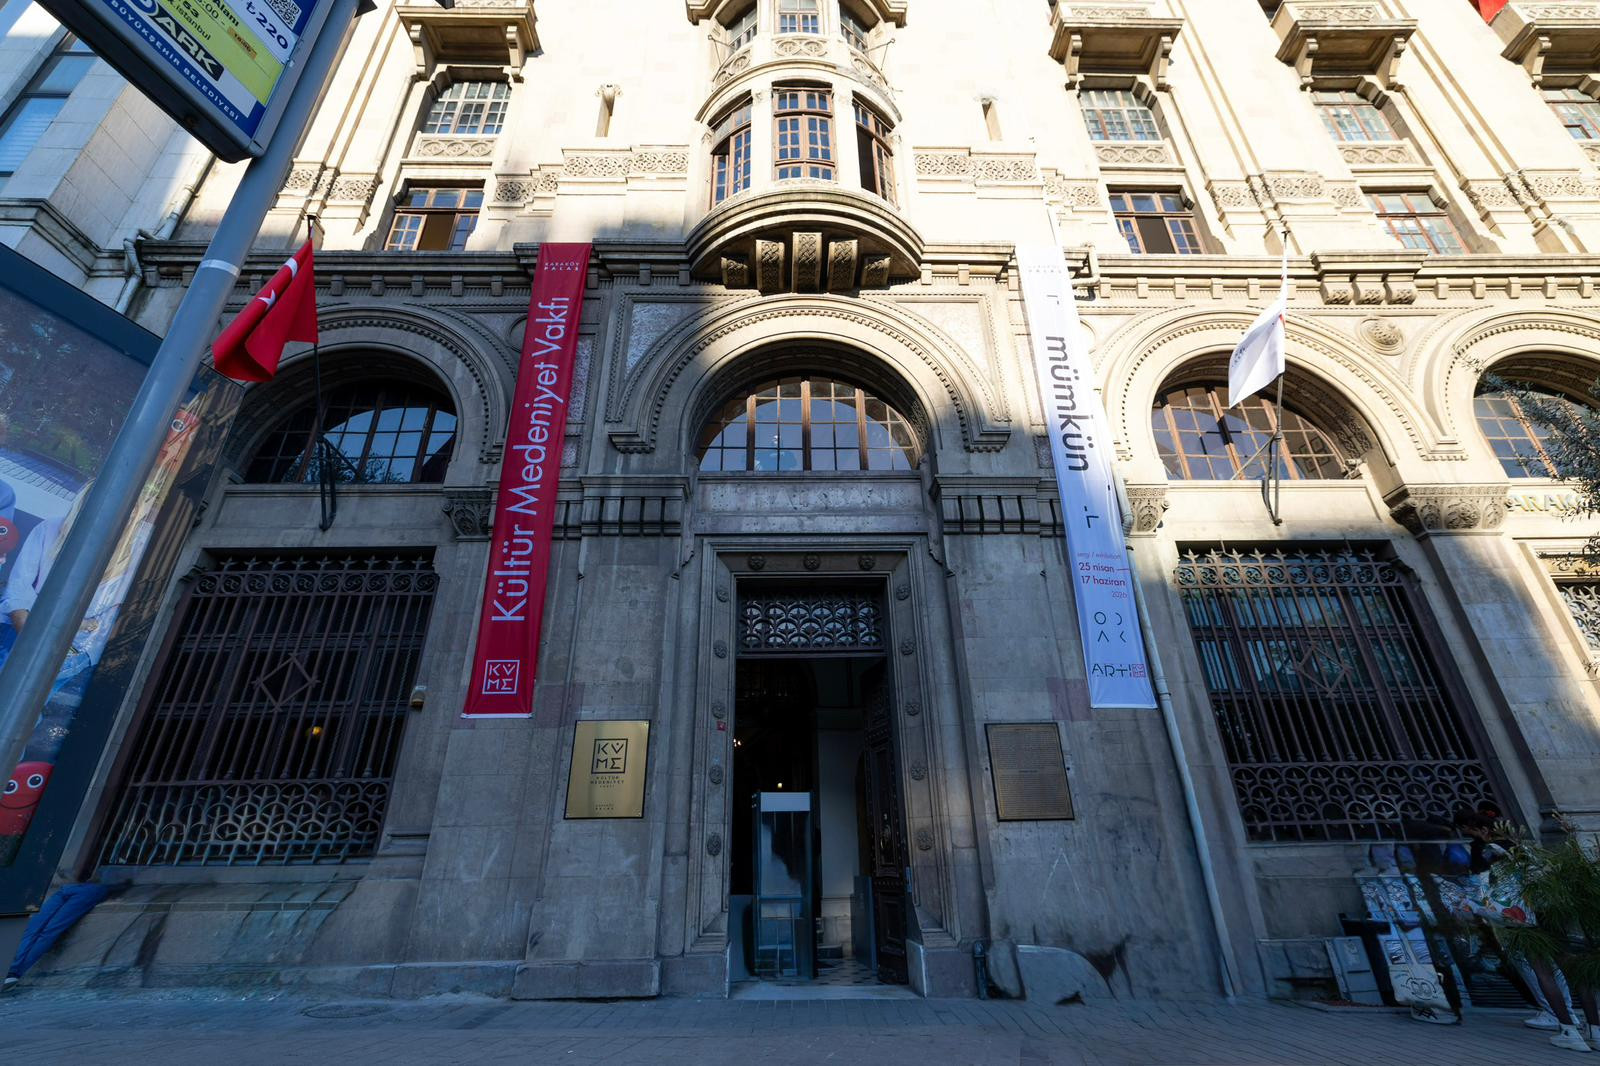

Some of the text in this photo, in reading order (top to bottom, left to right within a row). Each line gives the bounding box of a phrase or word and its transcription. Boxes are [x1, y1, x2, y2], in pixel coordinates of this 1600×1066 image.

[183, 67, 239, 121] BELEDİYESİ
[1045, 335, 1094, 472] mümkün
[491, 297, 570, 621] Kültür Medeniyet Vakfı
[1078, 562, 1091, 571] 25
[1093, 563, 1115, 573] nisan
[1081, 575, 1126, 586] 17 haziran
